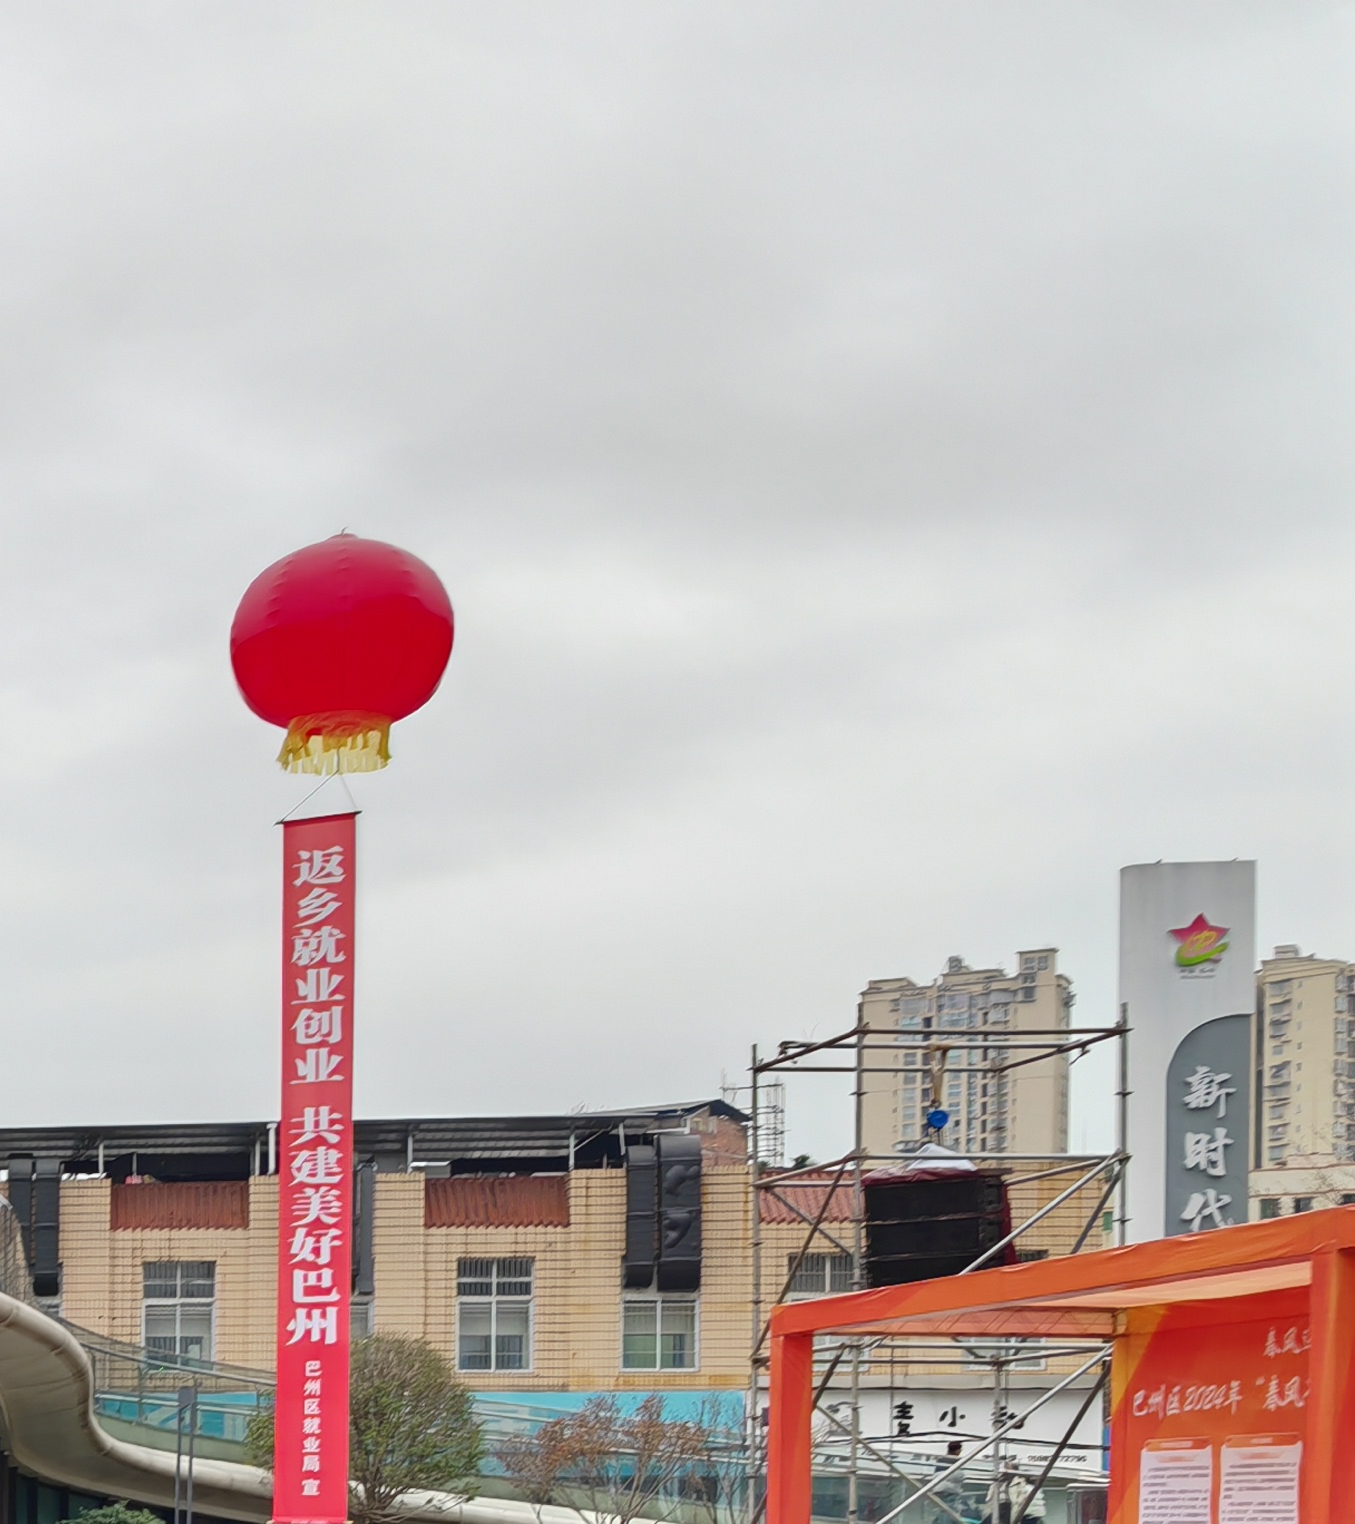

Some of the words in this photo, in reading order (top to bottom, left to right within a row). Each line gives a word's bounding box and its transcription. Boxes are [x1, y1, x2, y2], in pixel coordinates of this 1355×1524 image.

[290, 845, 347, 1086] 返乡就业创业
[1180, 1065, 1238, 1234] 新时代
[284, 1104, 345, 1347] 共建美好巴州
[300, 1359, 323, 1473] 巴州区就业局
[1132, 1374, 1311, 1421] 巴州区2024年“春风
[301, 1478, 321, 1497] 宣
